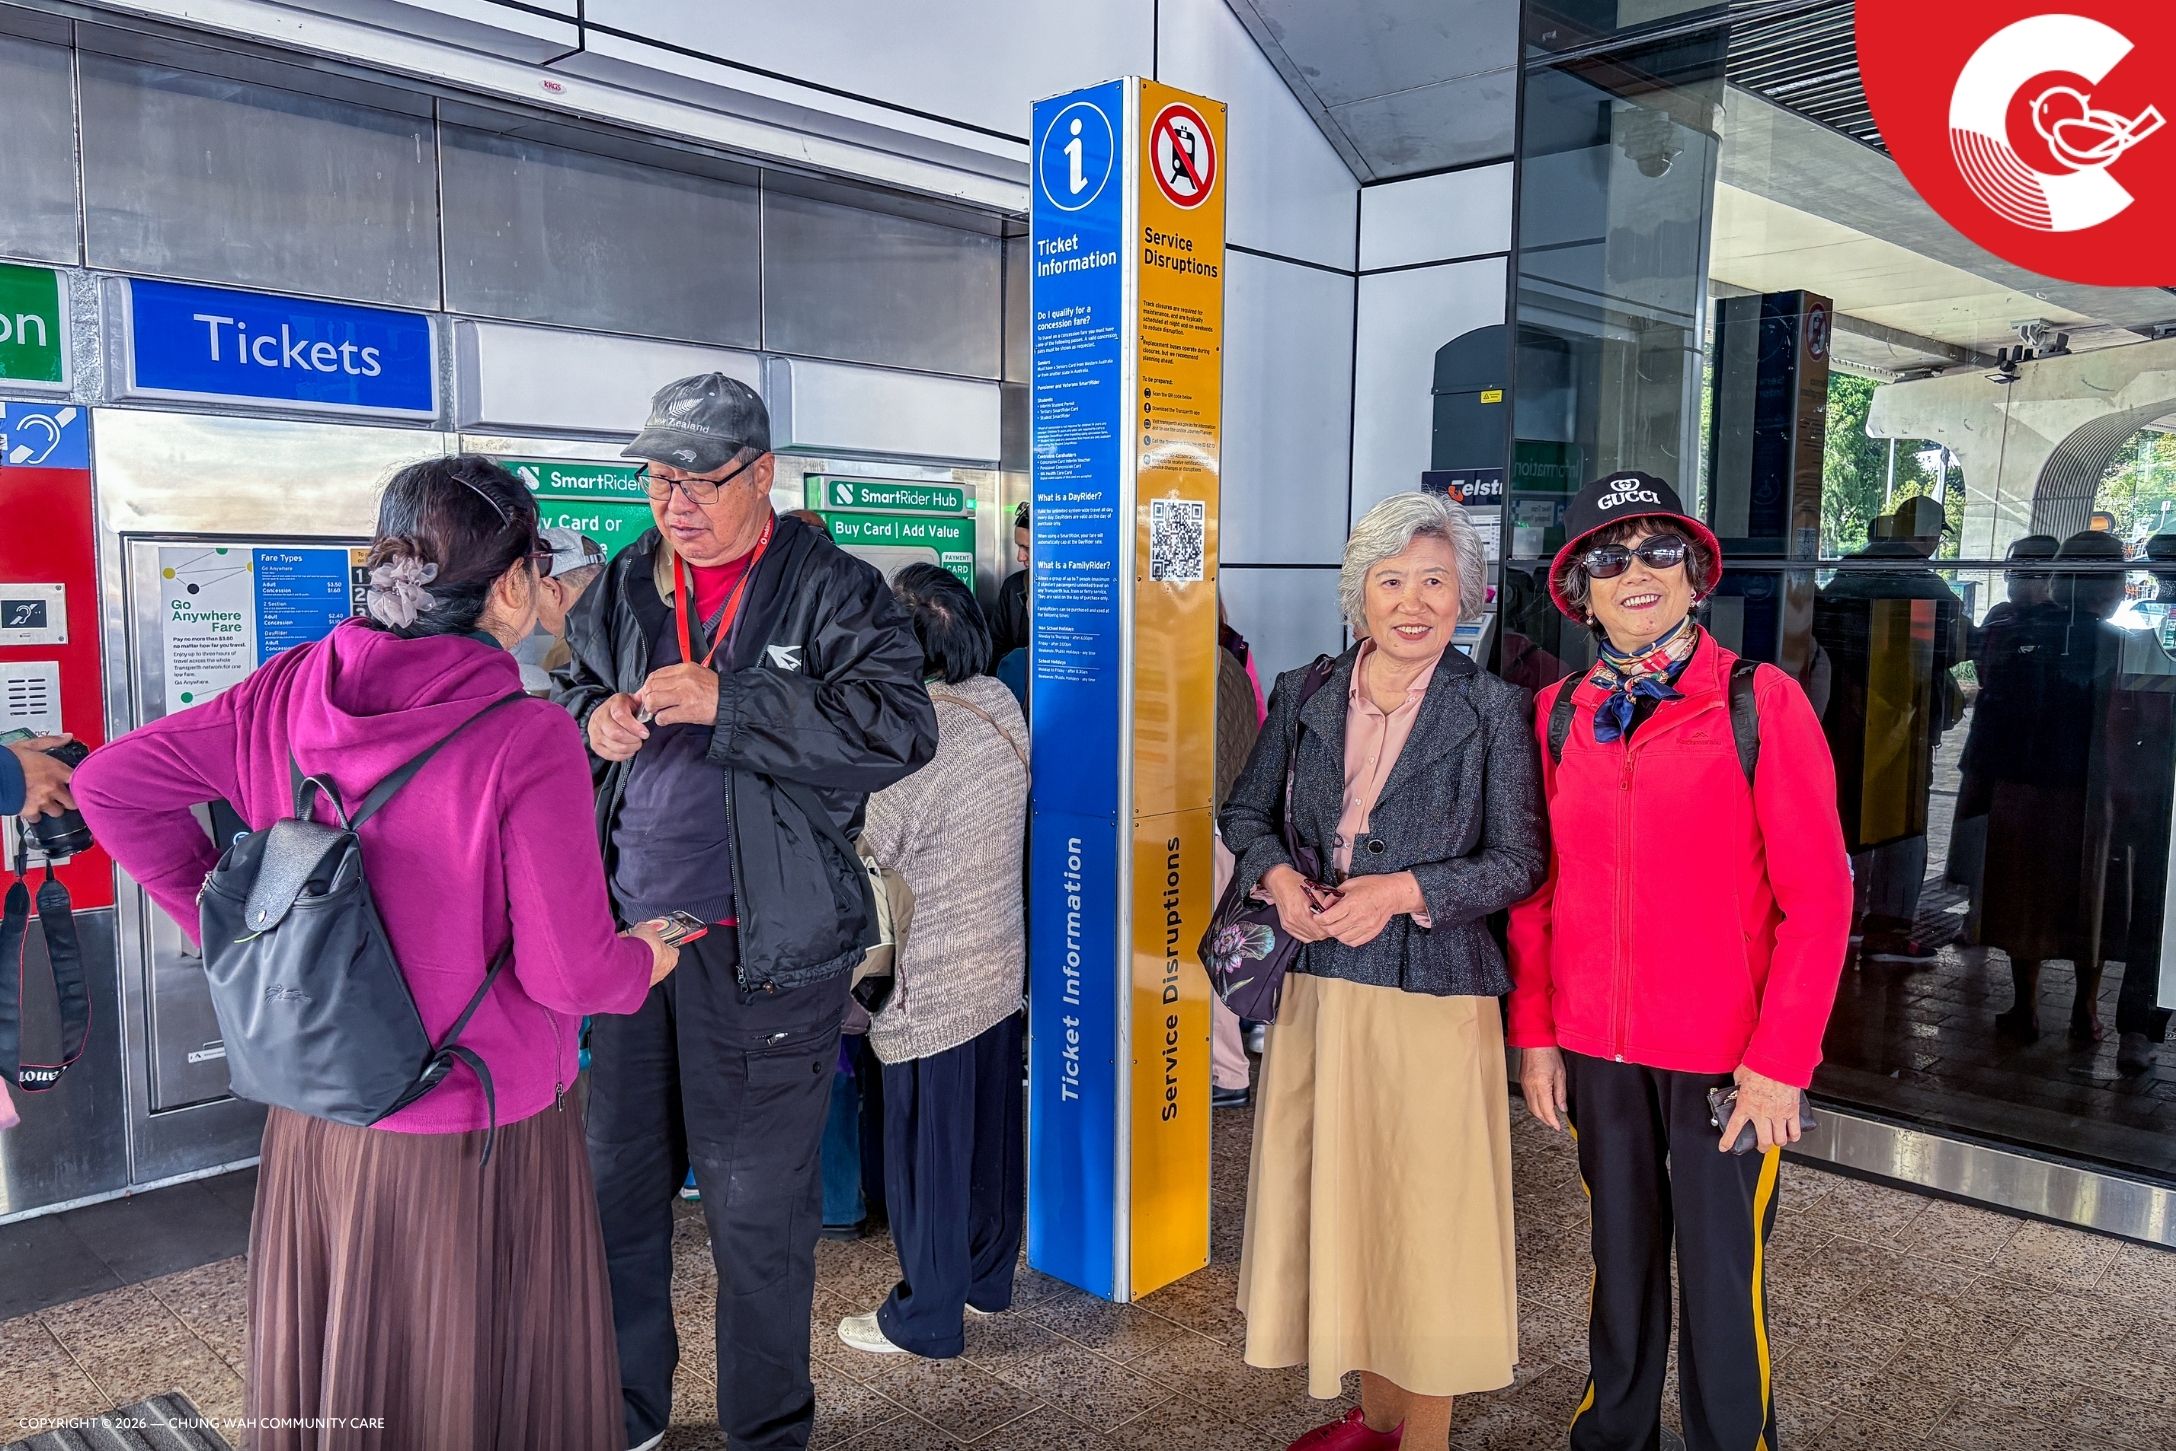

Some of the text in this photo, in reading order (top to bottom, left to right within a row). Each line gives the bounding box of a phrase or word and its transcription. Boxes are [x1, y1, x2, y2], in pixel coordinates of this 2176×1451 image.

[1038, 234, 1078, 256] Ticket
[1145, 227, 1192, 252] Service
[1038, 252, 1116, 277] Information
[1145, 248, 1218, 277] Disruptions
[1052, 307, 1073, 318] qualify
[1076, 306, 1085, 314] for
[1038, 316, 1090, 330] concession fare?
[193, 313, 381, 376] Tickets
[669, 418, 709, 433] Zealand
[861, 489, 957, 506] SmartRider Hub
[1038, 493, 1053, 501] What
[1069, 492, 1102, 502] DayRider?
[1598, 490, 1661, 509] GUCCI
[559, 515, 598, 531] Card
[605, 519, 622, 531] or
[836, 522, 959, 537] Buy Card Add Value
[280, 554, 302, 562] Types
[1038, 561, 1053, 569] What
[1069, 561, 1110, 570] FamilyRider?
[356, 569, 363, 583] 1
[947, 565, 968, 573] CARD
[355, 588, 365, 601] 2
[171, 600, 191, 609] Go
[172, 610, 241, 623] Anywhere
[212, 623, 241, 632] Fare
[1061, 836, 1082, 1102] Ticket Information
[1162, 836, 1182, 1122] Service Disruptions
